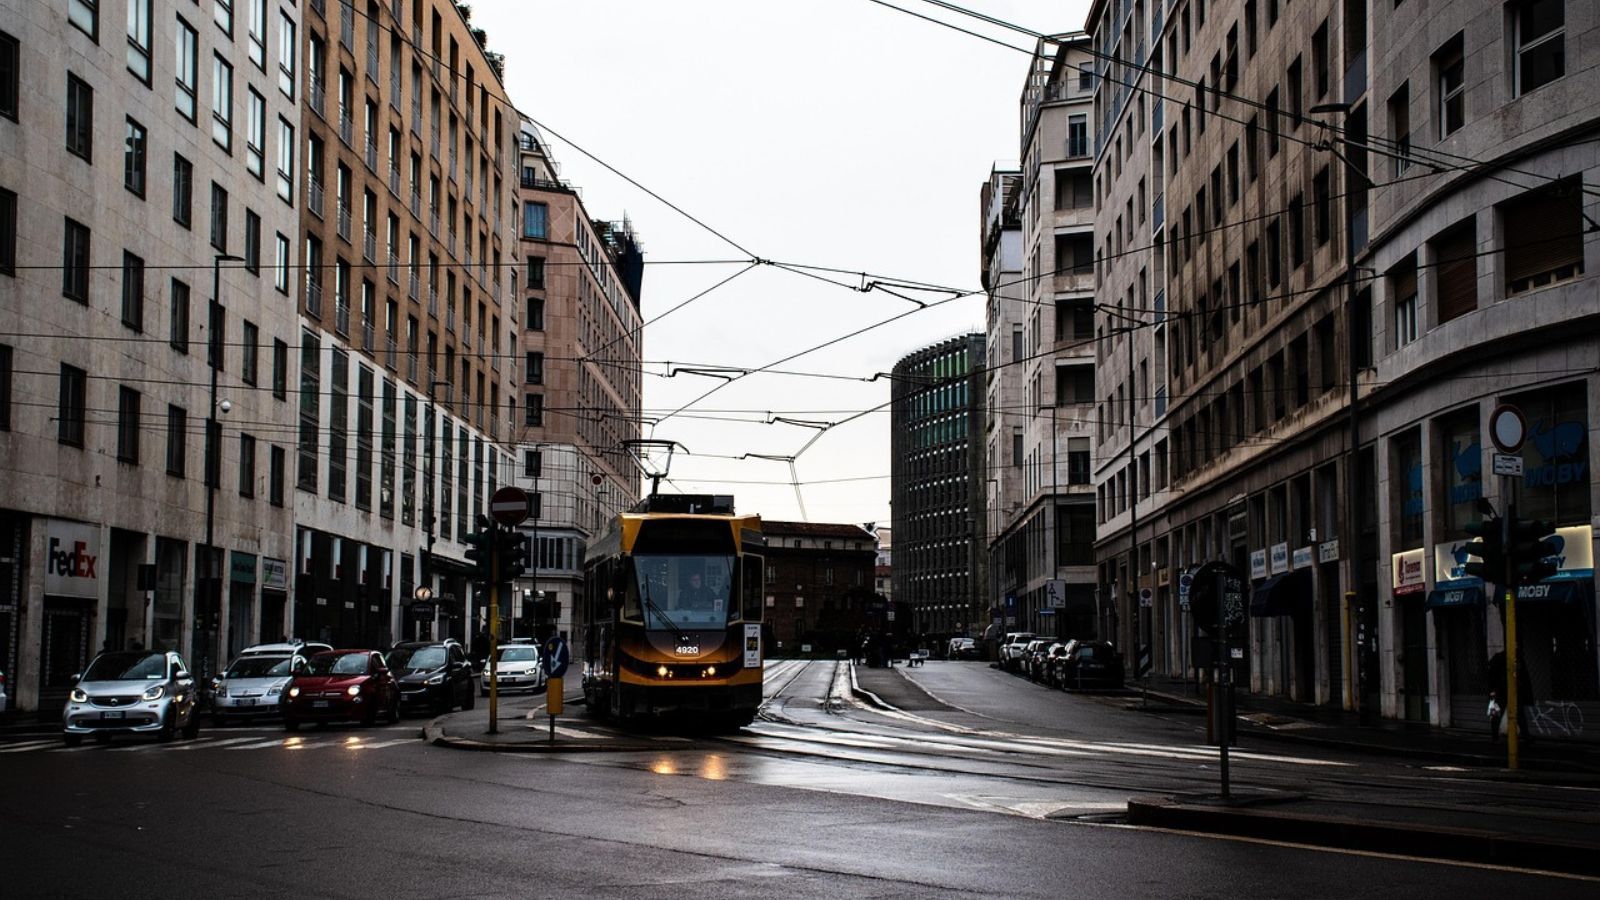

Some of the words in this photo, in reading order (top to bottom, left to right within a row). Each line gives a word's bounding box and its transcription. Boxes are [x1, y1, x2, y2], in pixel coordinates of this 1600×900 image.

[1525, 463, 1585, 488] MOBY
[48, 537, 96, 578] FedEx
[1443, 590, 1464, 602] MOBY
[1518, 584, 1551, 599] MOBY
[676, 646, 699, 654] 4920
